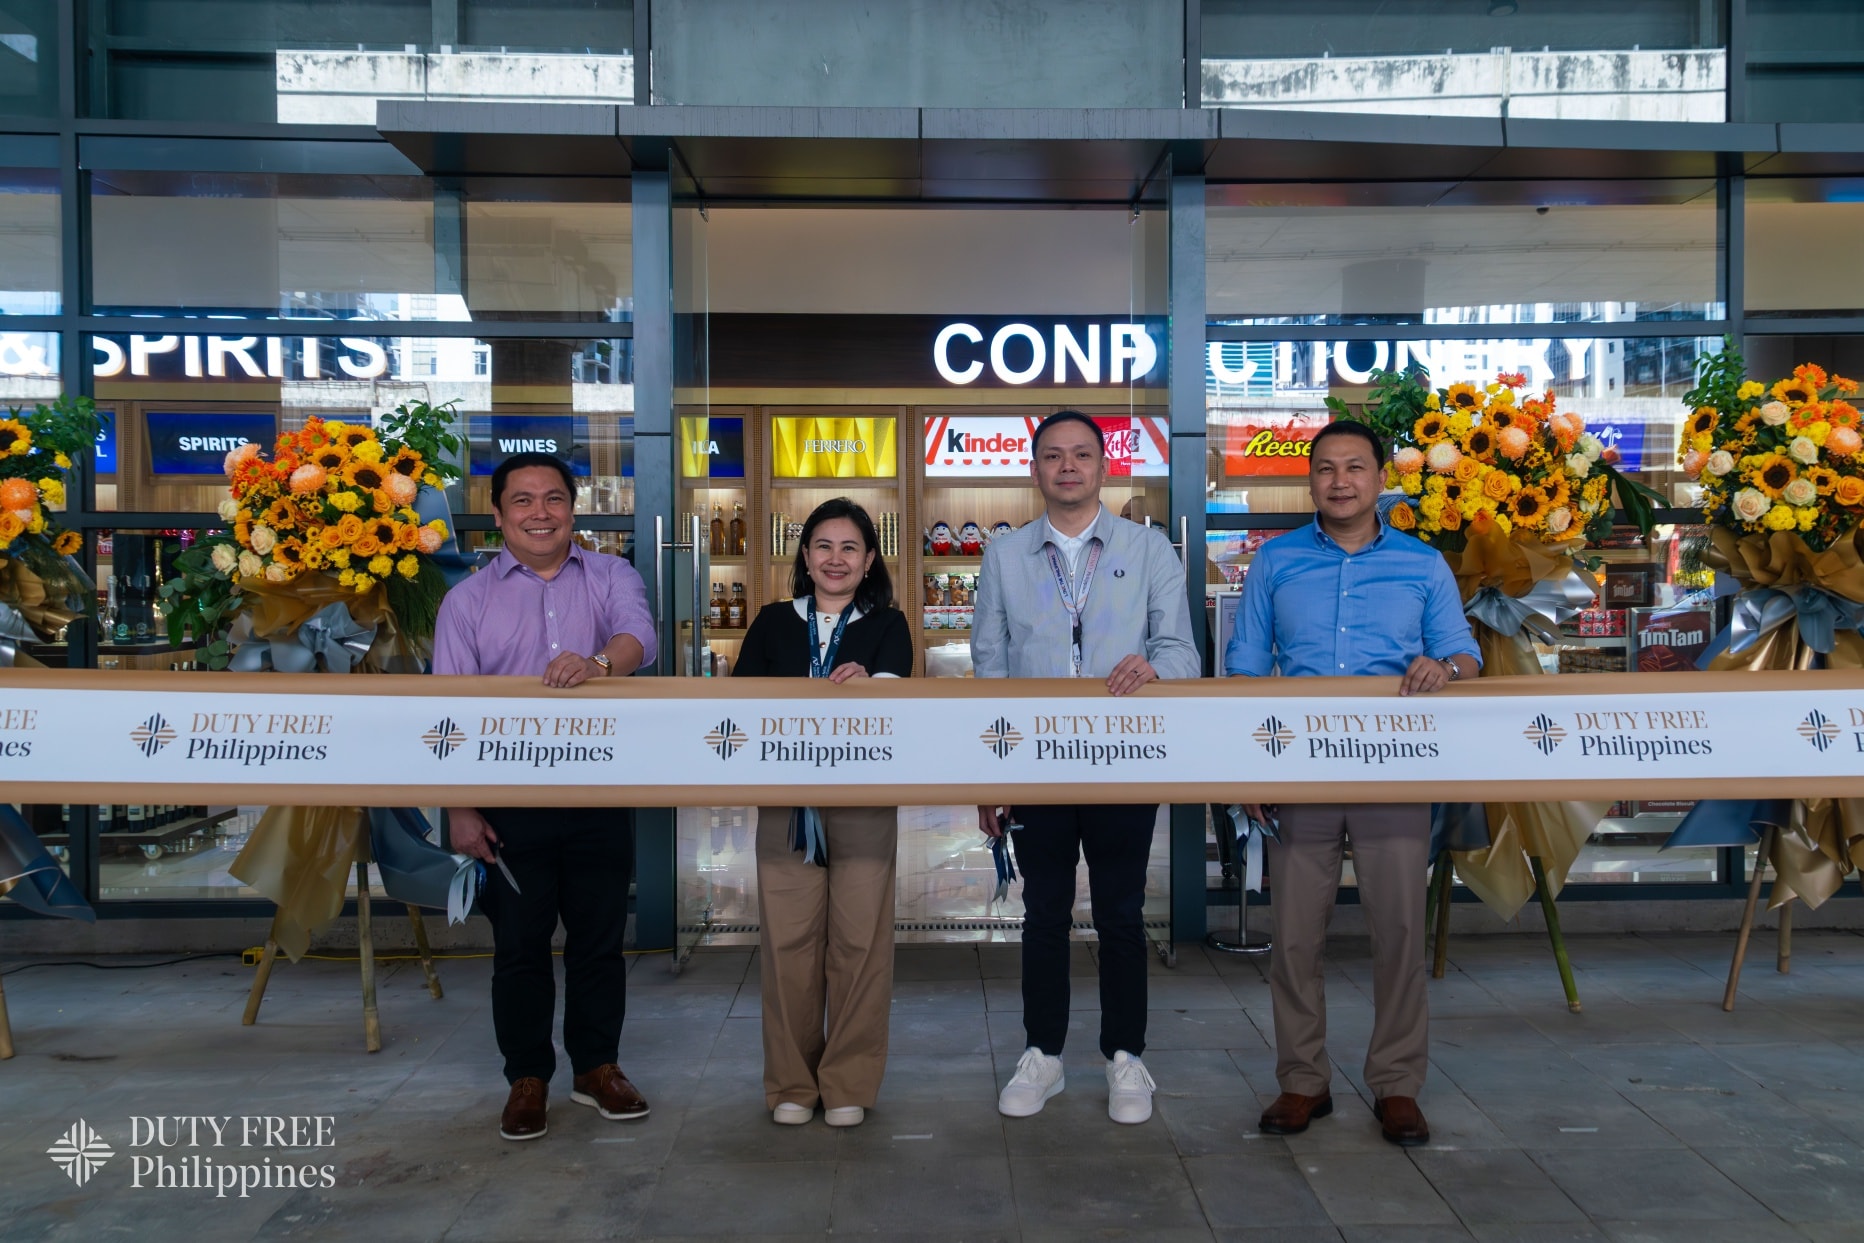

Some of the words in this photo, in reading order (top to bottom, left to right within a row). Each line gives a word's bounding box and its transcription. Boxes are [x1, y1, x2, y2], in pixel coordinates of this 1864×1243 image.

[179, 436, 250, 452] SPIRITS
[498, 438, 558, 453] WINES
[804, 439, 867, 453] FERRERO
[189, 712, 262, 734] DUTY
[265, 714, 333, 735] FREE
[479, 716, 549, 736] DUTY
[552, 717, 617, 736] FREE
[760, 717, 827, 736] DUTY
[831, 717, 893, 736] FREE
[1033, 715, 1099, 735] DUTY
[1103, 715, 1166, 734] FREE
[1304, 714, 1369, 733] DUTY
[1373, 713, 1437, 733] FREE
[1574, 711, 1640, 731] DUTY
[1644, 710, 1709, 730] FREE
[186, 737, 328, 767] Philippines
[476, 740, 614, 768] Philippines
[759, 741, 893, 767] Philippines
[1034, 739, 1167, 766] Philippines
[1307, 737, 1440, 764] Philippines
[1578, 734, 1713, 762] Philippines
